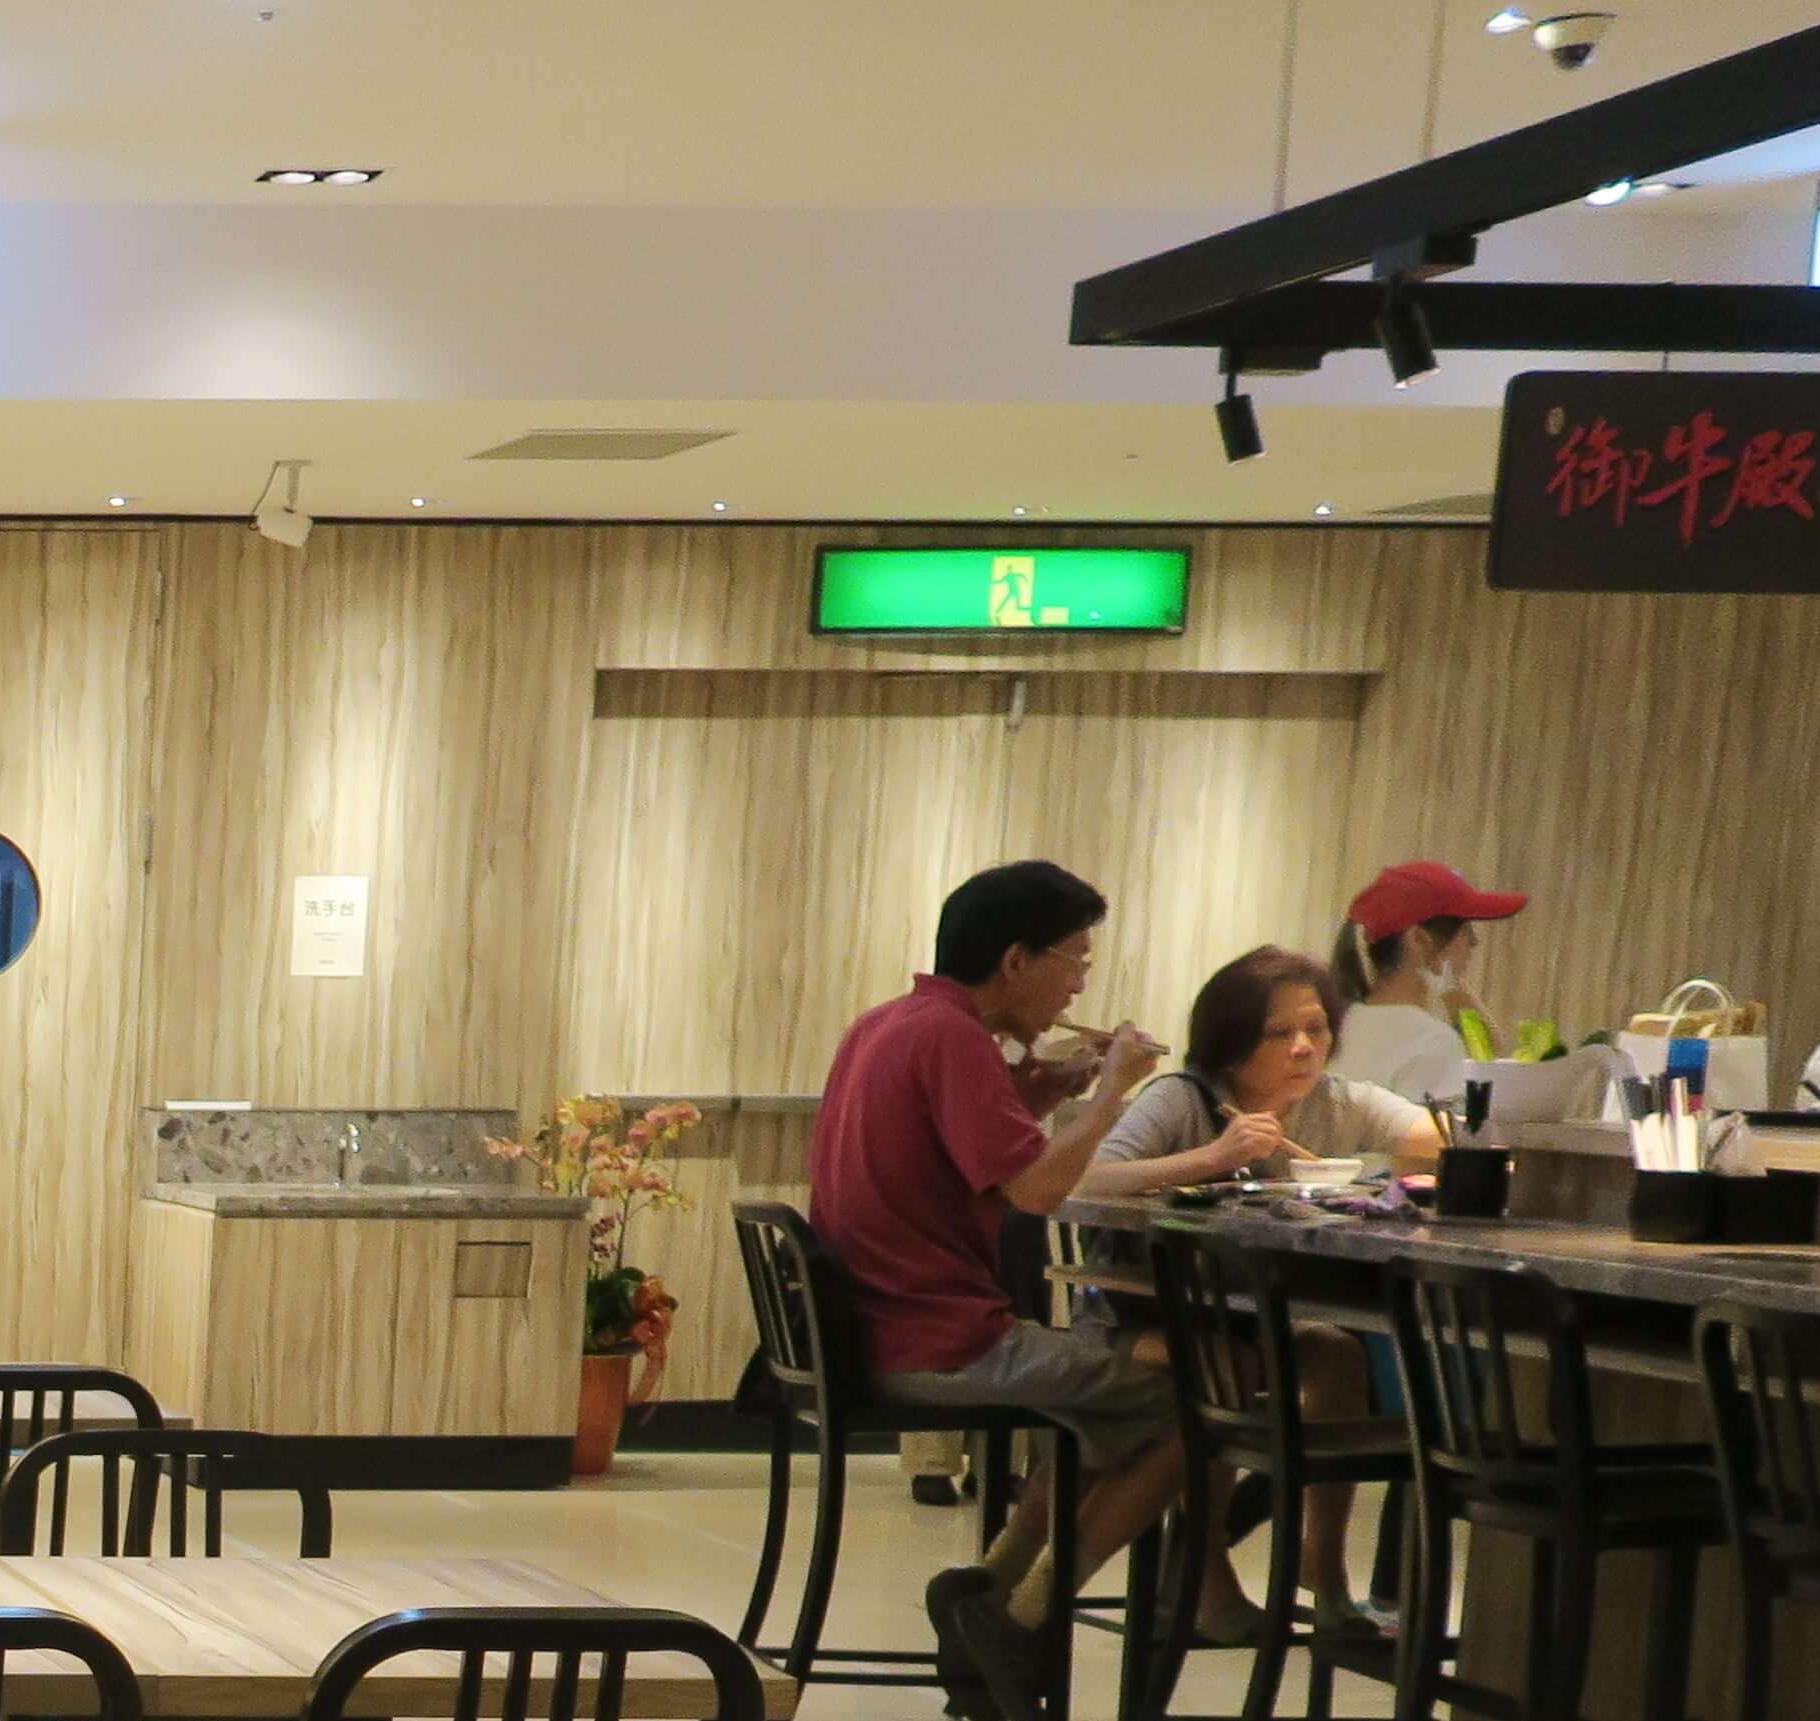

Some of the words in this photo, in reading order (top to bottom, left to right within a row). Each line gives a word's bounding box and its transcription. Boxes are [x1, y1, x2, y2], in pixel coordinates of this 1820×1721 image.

[1545, 410, 1817, 543] 御牛殿
[304, 899, 355, 918] 洗手台
